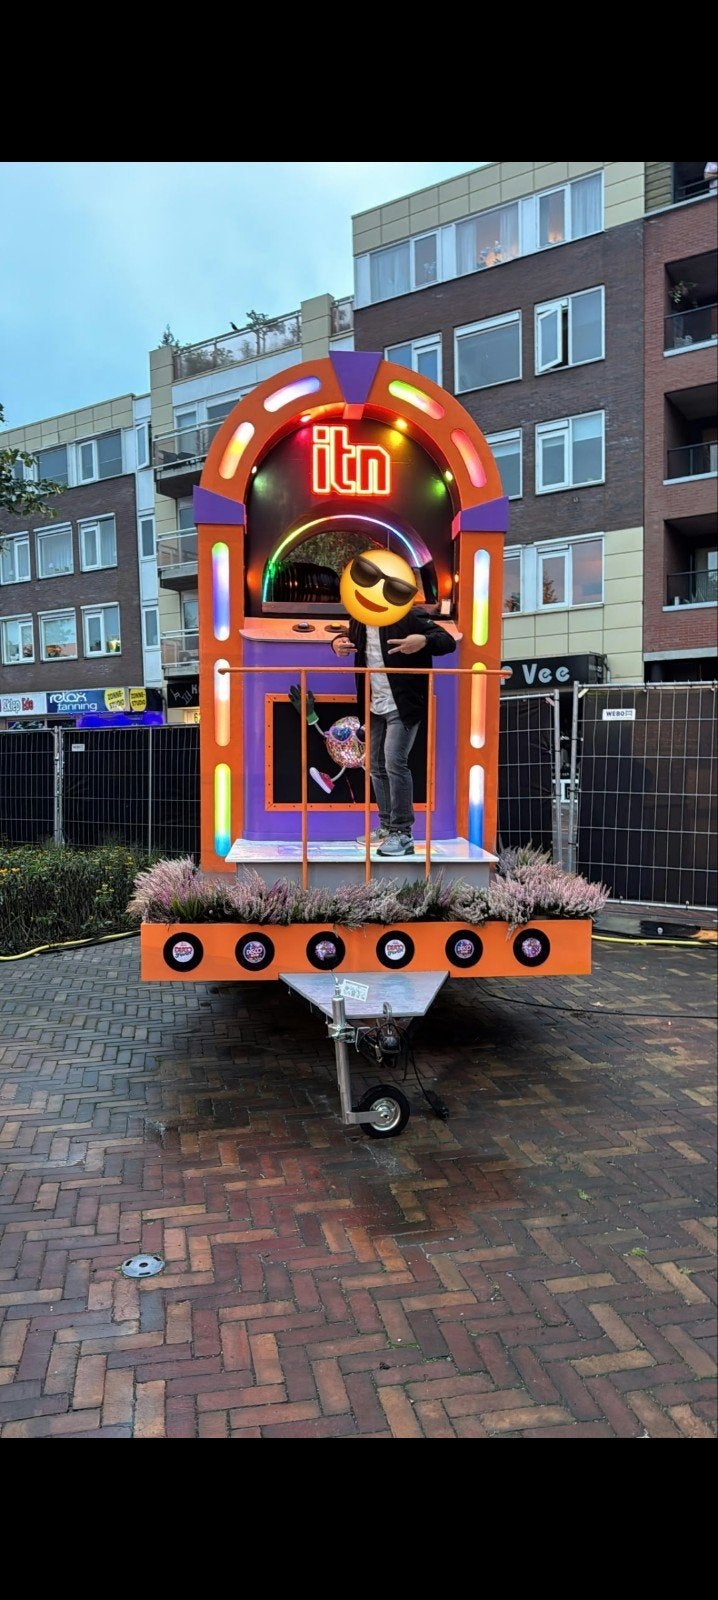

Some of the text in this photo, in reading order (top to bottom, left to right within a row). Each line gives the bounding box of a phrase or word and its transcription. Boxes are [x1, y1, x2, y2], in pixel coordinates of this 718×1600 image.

[312, 425, 391, 494] itn
[522, 663, 570, 685] Vee
[50, 692, 87, 703] relax
[57, 702, 98, 712] tanning
